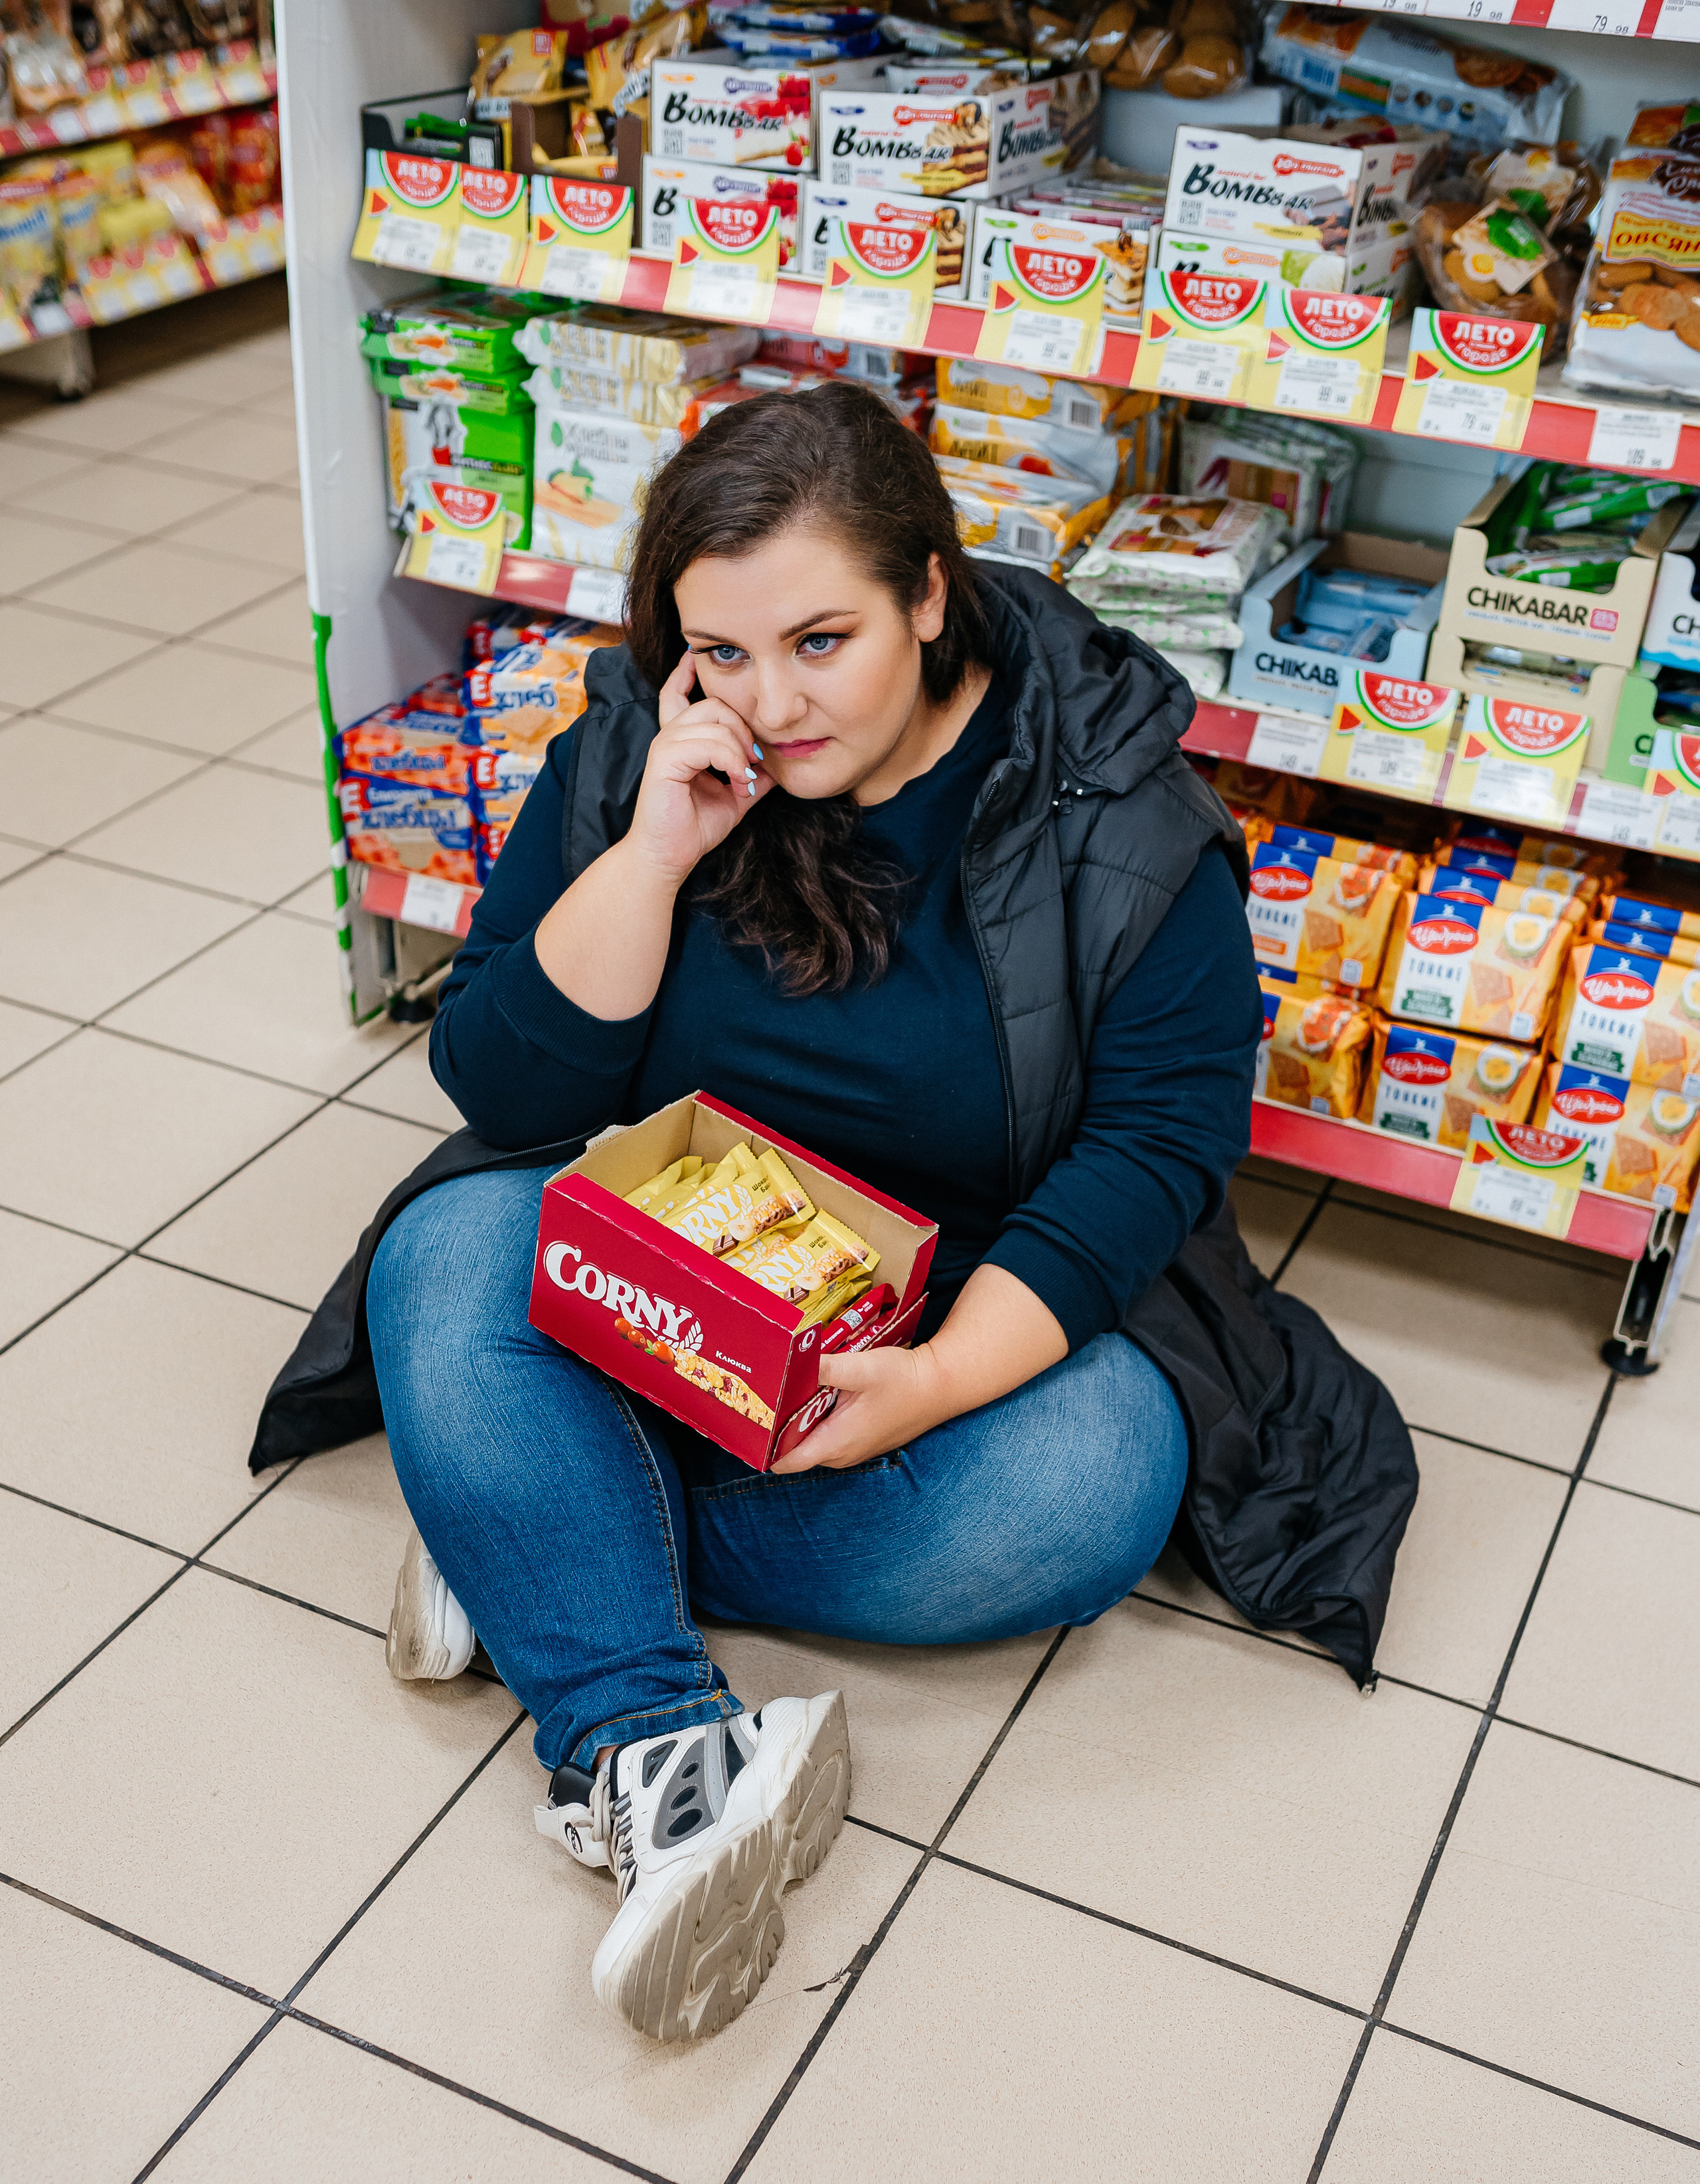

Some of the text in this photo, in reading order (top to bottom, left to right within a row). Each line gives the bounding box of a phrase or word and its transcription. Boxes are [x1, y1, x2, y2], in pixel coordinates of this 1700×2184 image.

[1467, 1, 1502, 20] 19 98
[1593, 15, 1629, 35] 79 98
[708, 207, 757, 227] ЛЕТО
[861, 230, 912, 250] ЛЕТО
[1028, 253, 1082, 276] ЛЕТО
[1184, 279, 1241, 300] ЛЕТО
[1305, 298, 1363, 319] ЛЕТО
[1454, 321, 1515, 345] ЛЕТО
[1467, 586, 1588, 626] CHIKABAR
[1254, 652, 1339, 687] CHIKAB
[1377, 680, 1433, 706] ЛЕТО
[1505, 707, 1564, 731] ЛЕТО
[671, 1186, 740, 1245] ORNY
[545, 1242, 693, 1340] CORNY
[715, 1350, 752, 1374] Клюква
